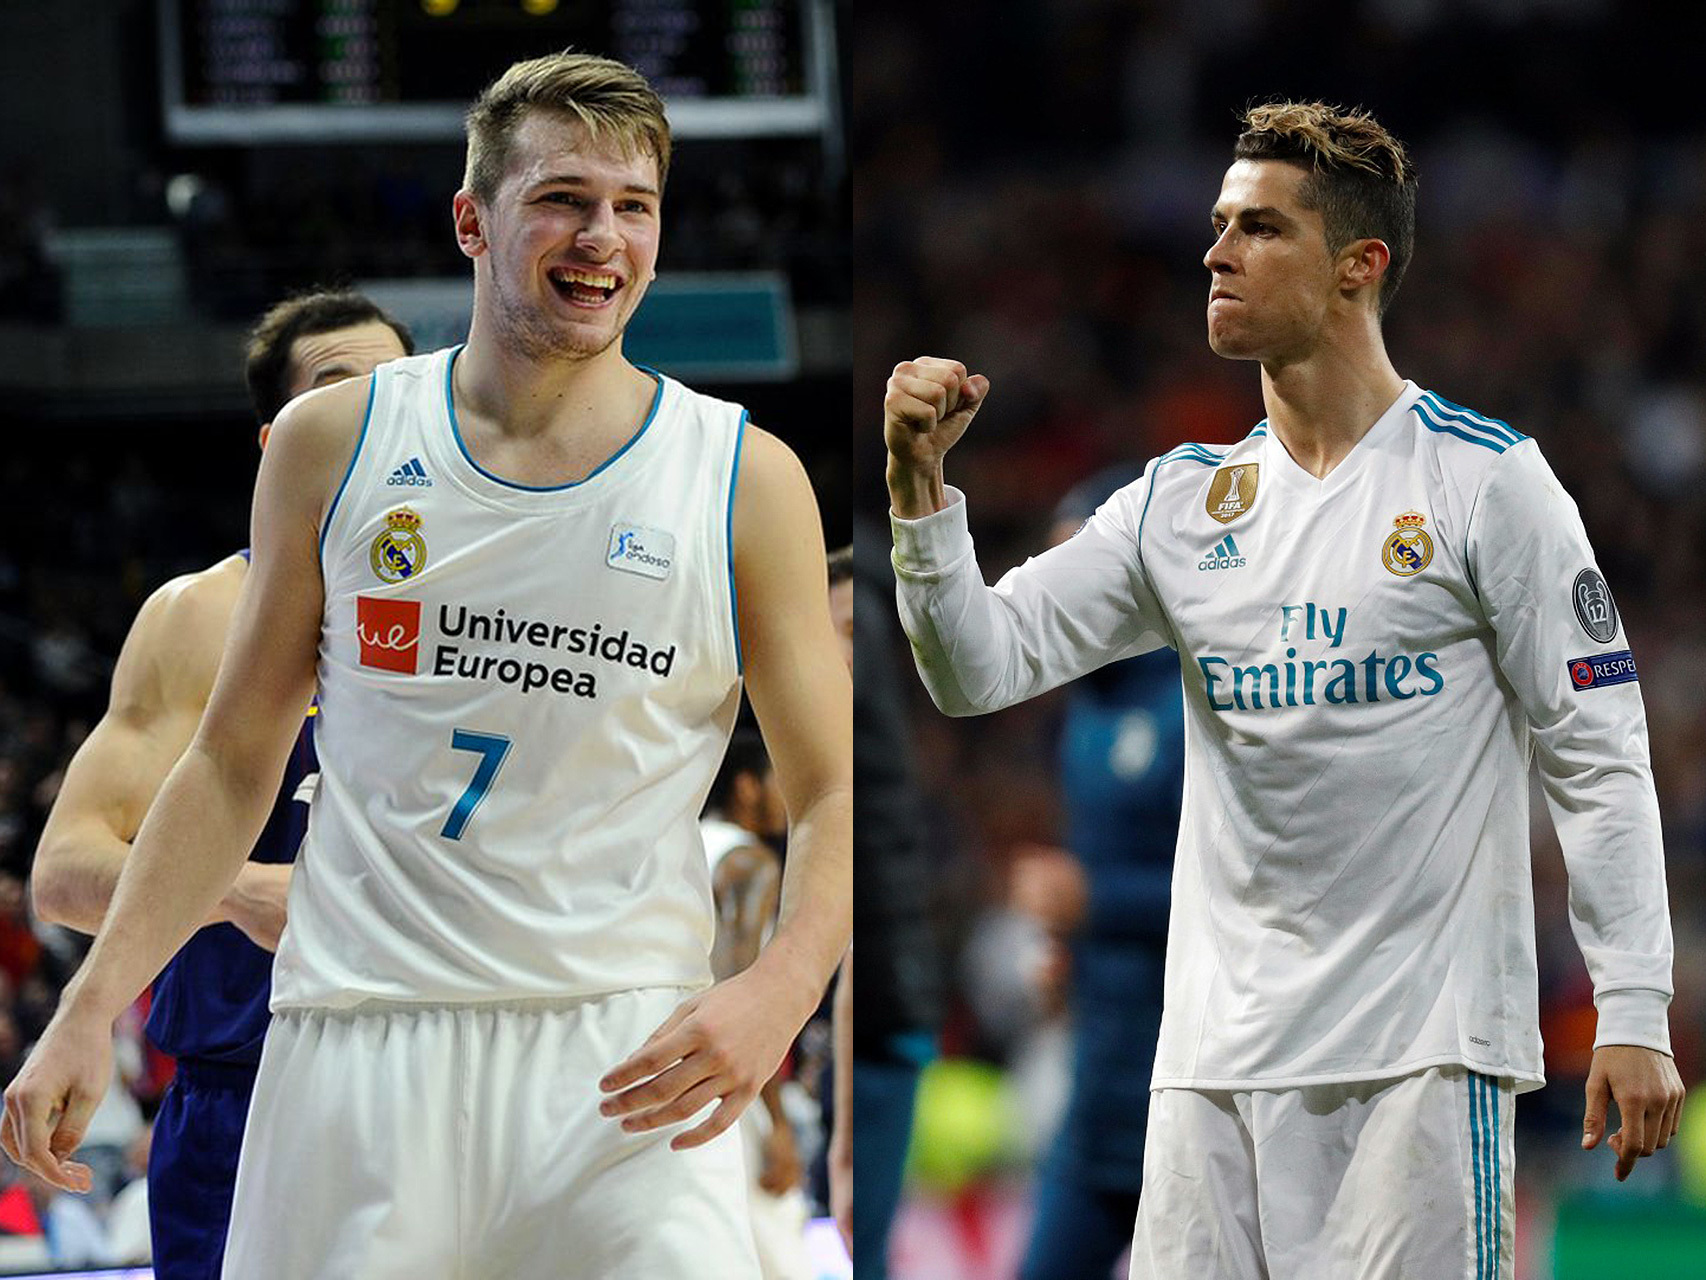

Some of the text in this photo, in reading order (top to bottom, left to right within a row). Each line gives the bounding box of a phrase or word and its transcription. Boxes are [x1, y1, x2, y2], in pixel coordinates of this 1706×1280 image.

[386, 475, 433, 487] adidas
[1217, 501, 1242, 511] FIFA
[1197, 555, 1247, 571] adidas
[1280, 602, 1348, 648] Fly
[1590, 603, 1607, 623] 12
[438, 604, 676, 678] Universidad
[433, 645, 597, 698] Europea
[1197, 647, 1445, 711] Emirates
[440, 728, 514, 841] 7
